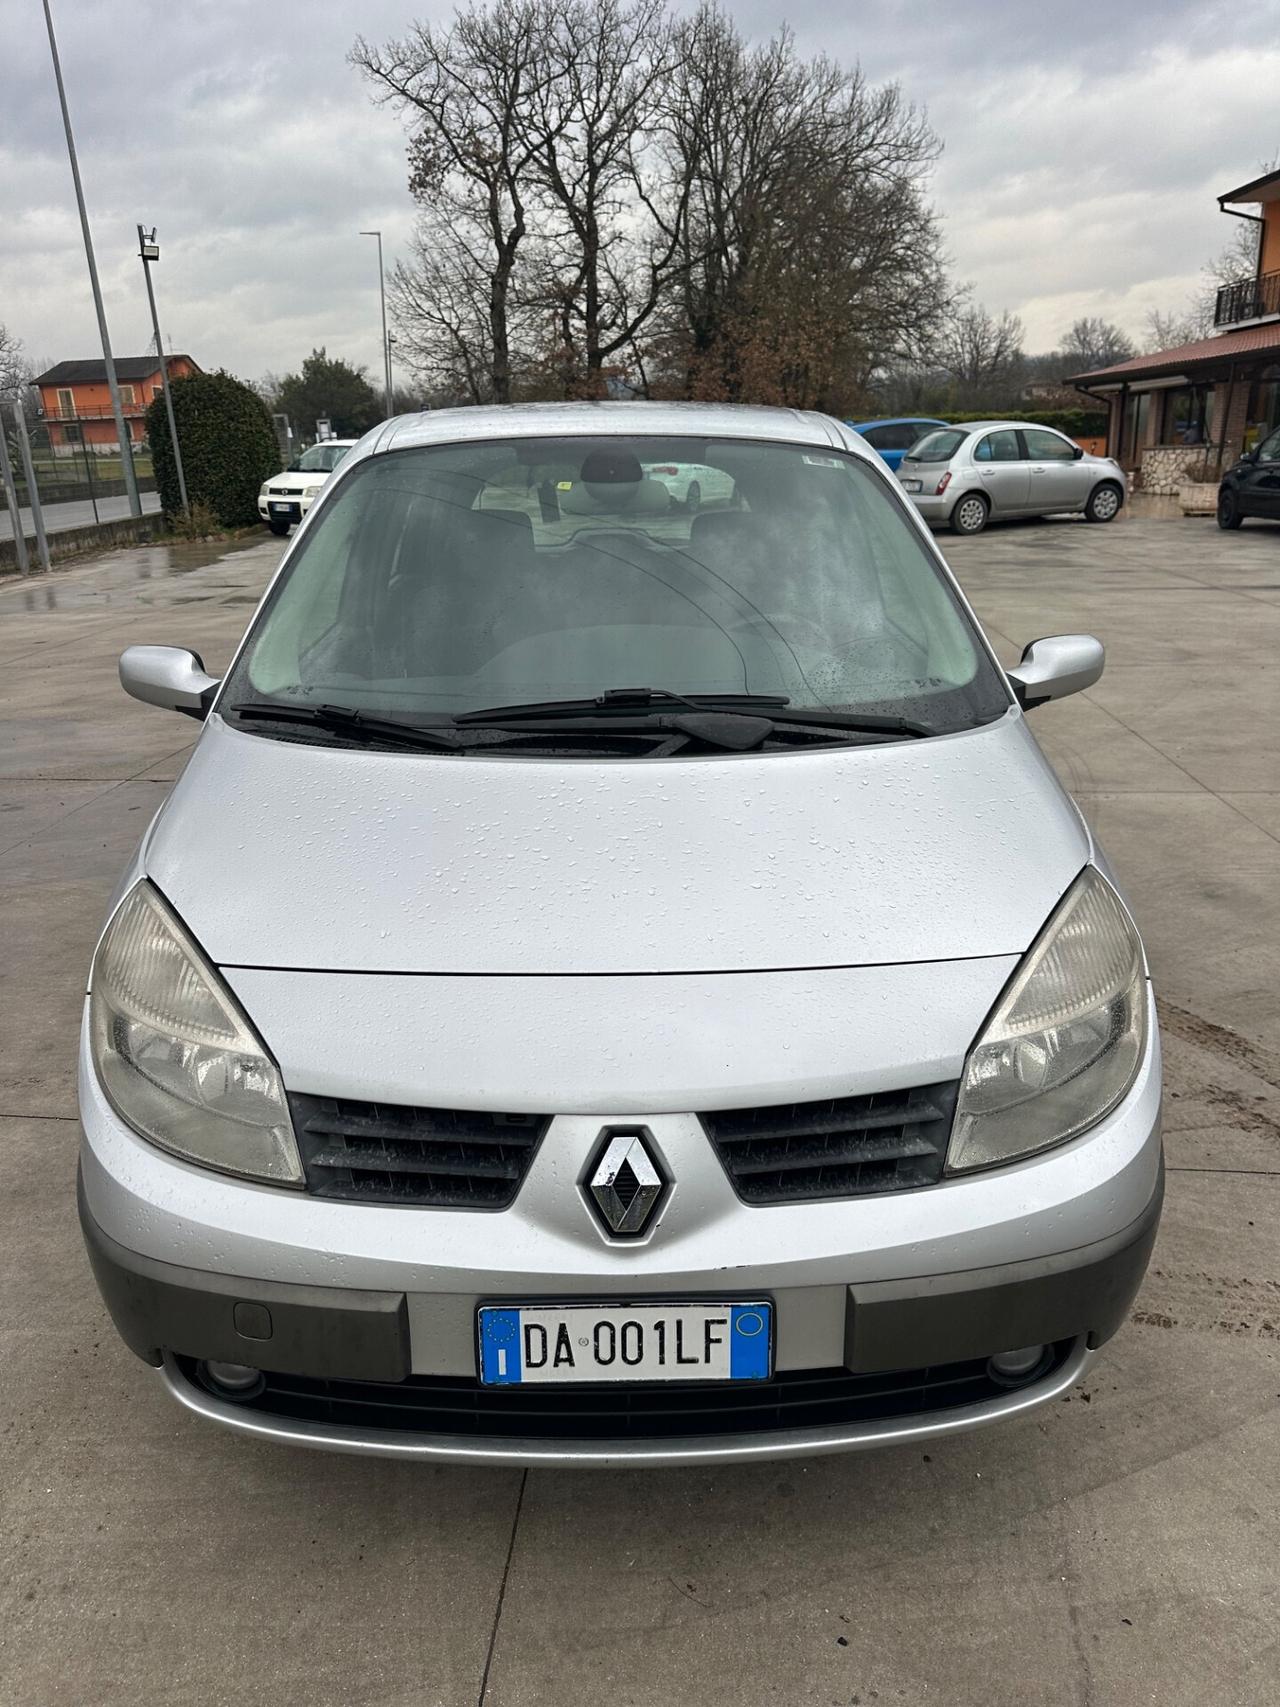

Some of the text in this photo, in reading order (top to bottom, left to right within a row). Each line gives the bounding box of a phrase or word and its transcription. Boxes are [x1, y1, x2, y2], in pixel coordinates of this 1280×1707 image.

[498, 1348, 507, 1376] I
[524, 1318, 728, 1368] DA 001LF
